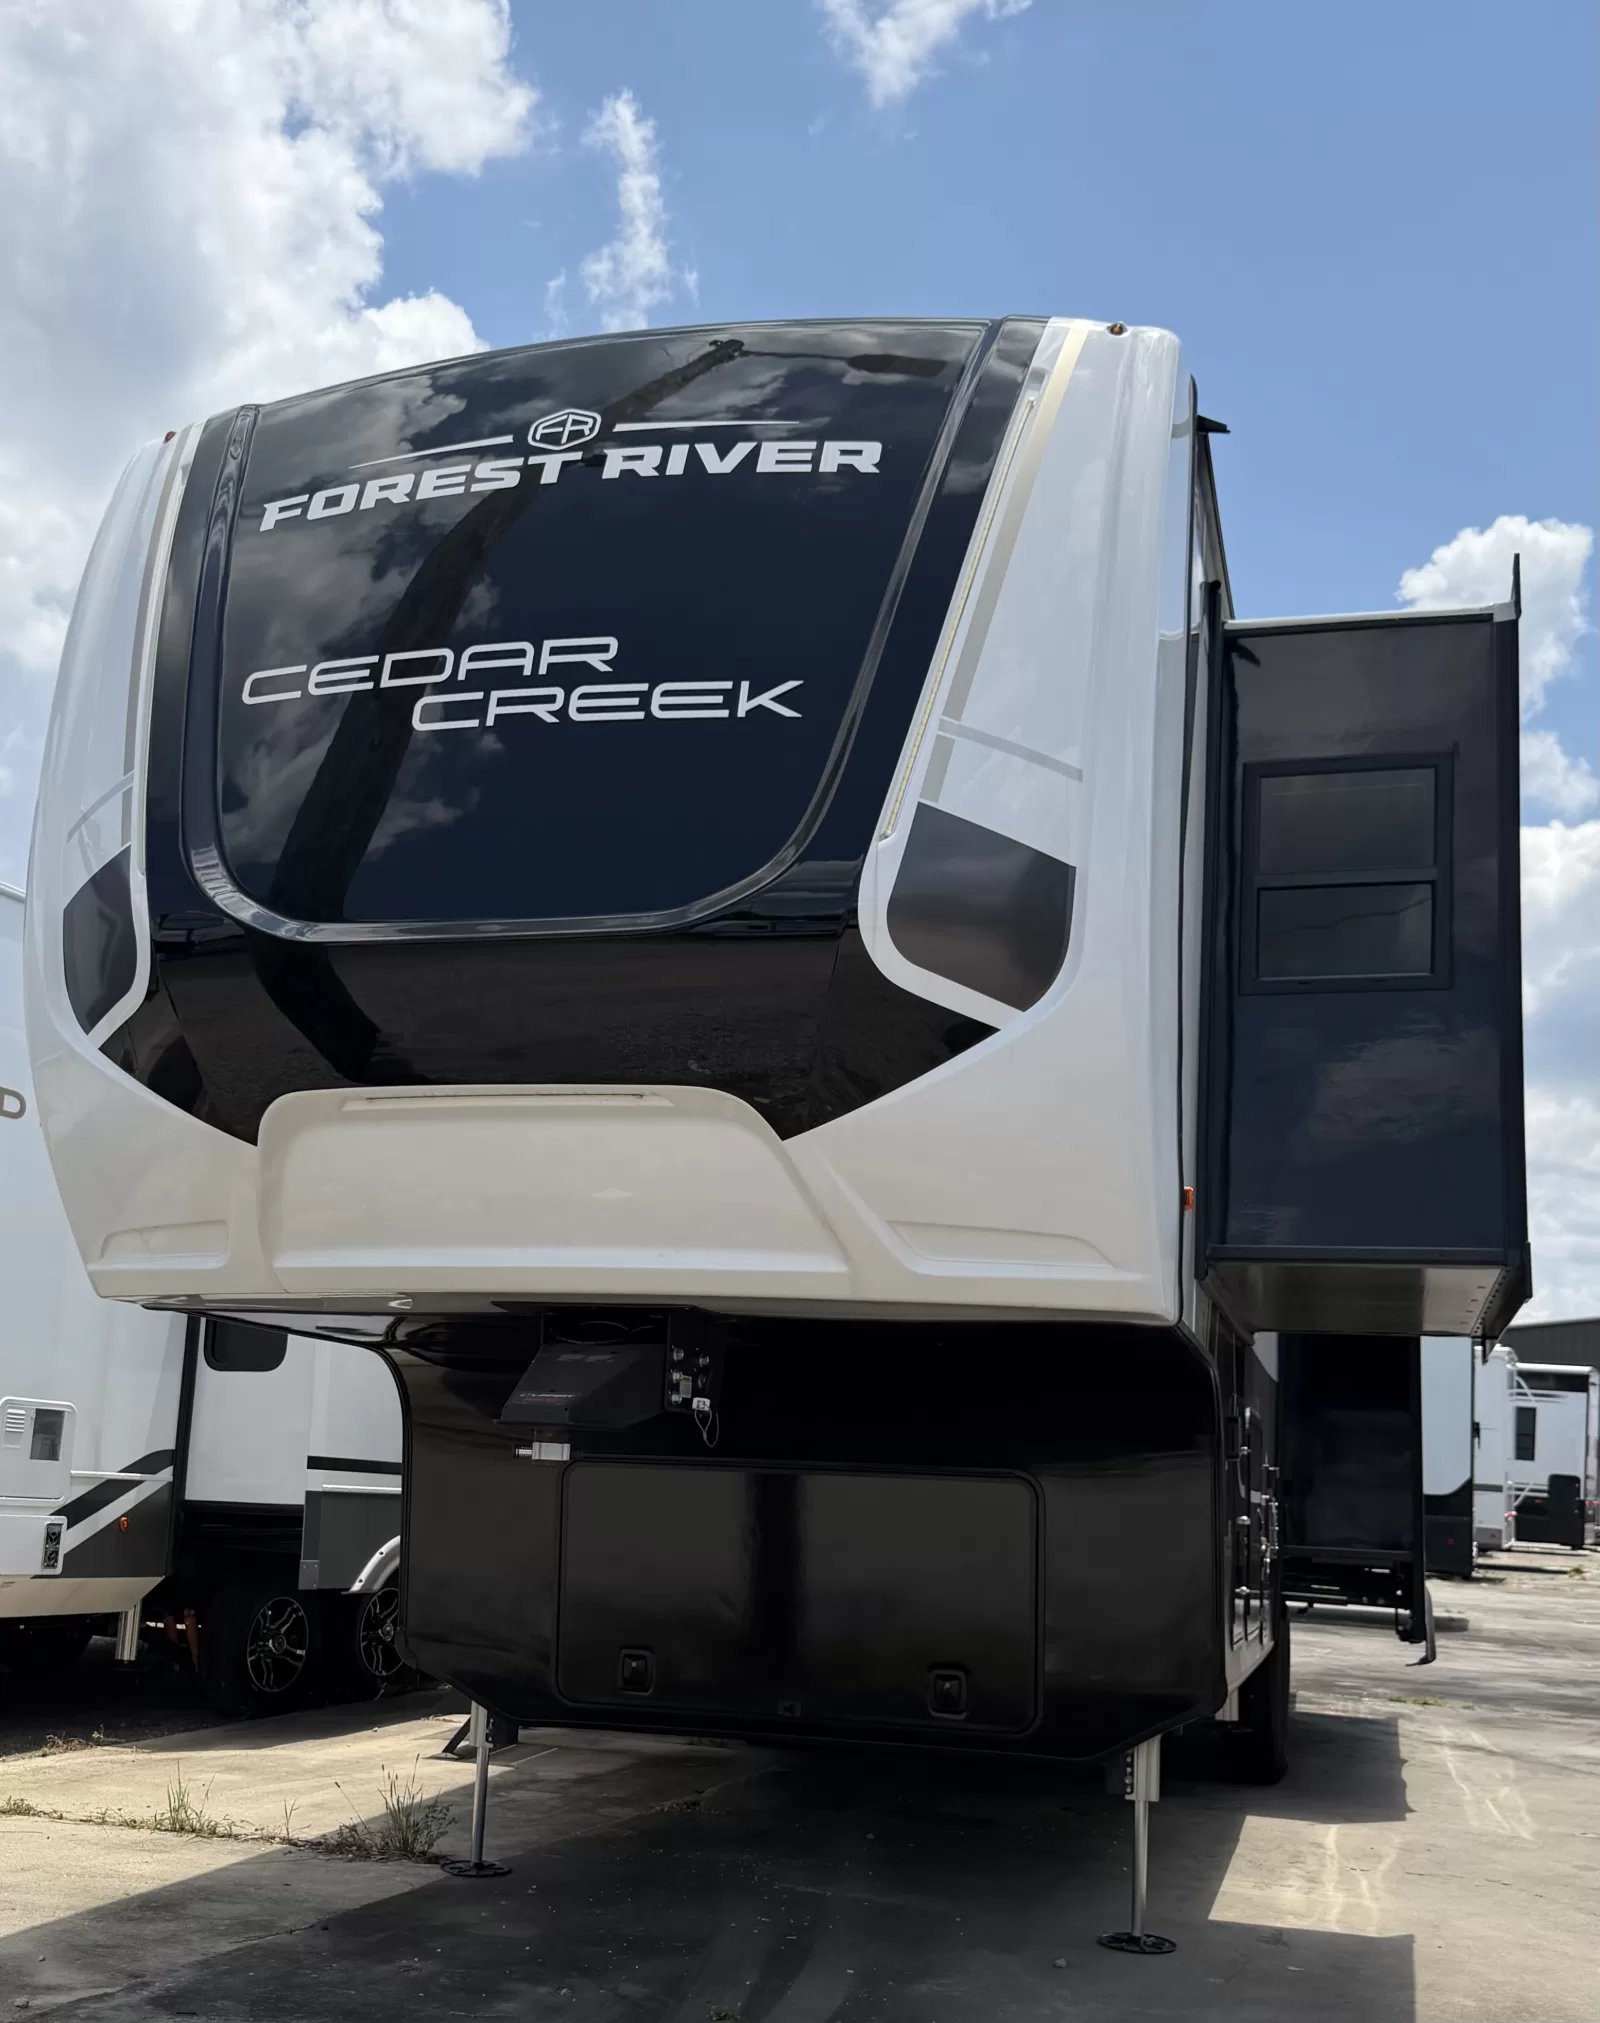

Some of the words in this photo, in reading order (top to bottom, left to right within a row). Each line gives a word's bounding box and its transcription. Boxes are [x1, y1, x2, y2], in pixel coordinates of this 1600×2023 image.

[535, 413, 594, 445] FR
[259, 451, 583, 532] FOREST
[602, 440, 883, 480] RIVER
[241, 636, 619, 707] CEDAR
[411, 680, 803, 732] CREEK
